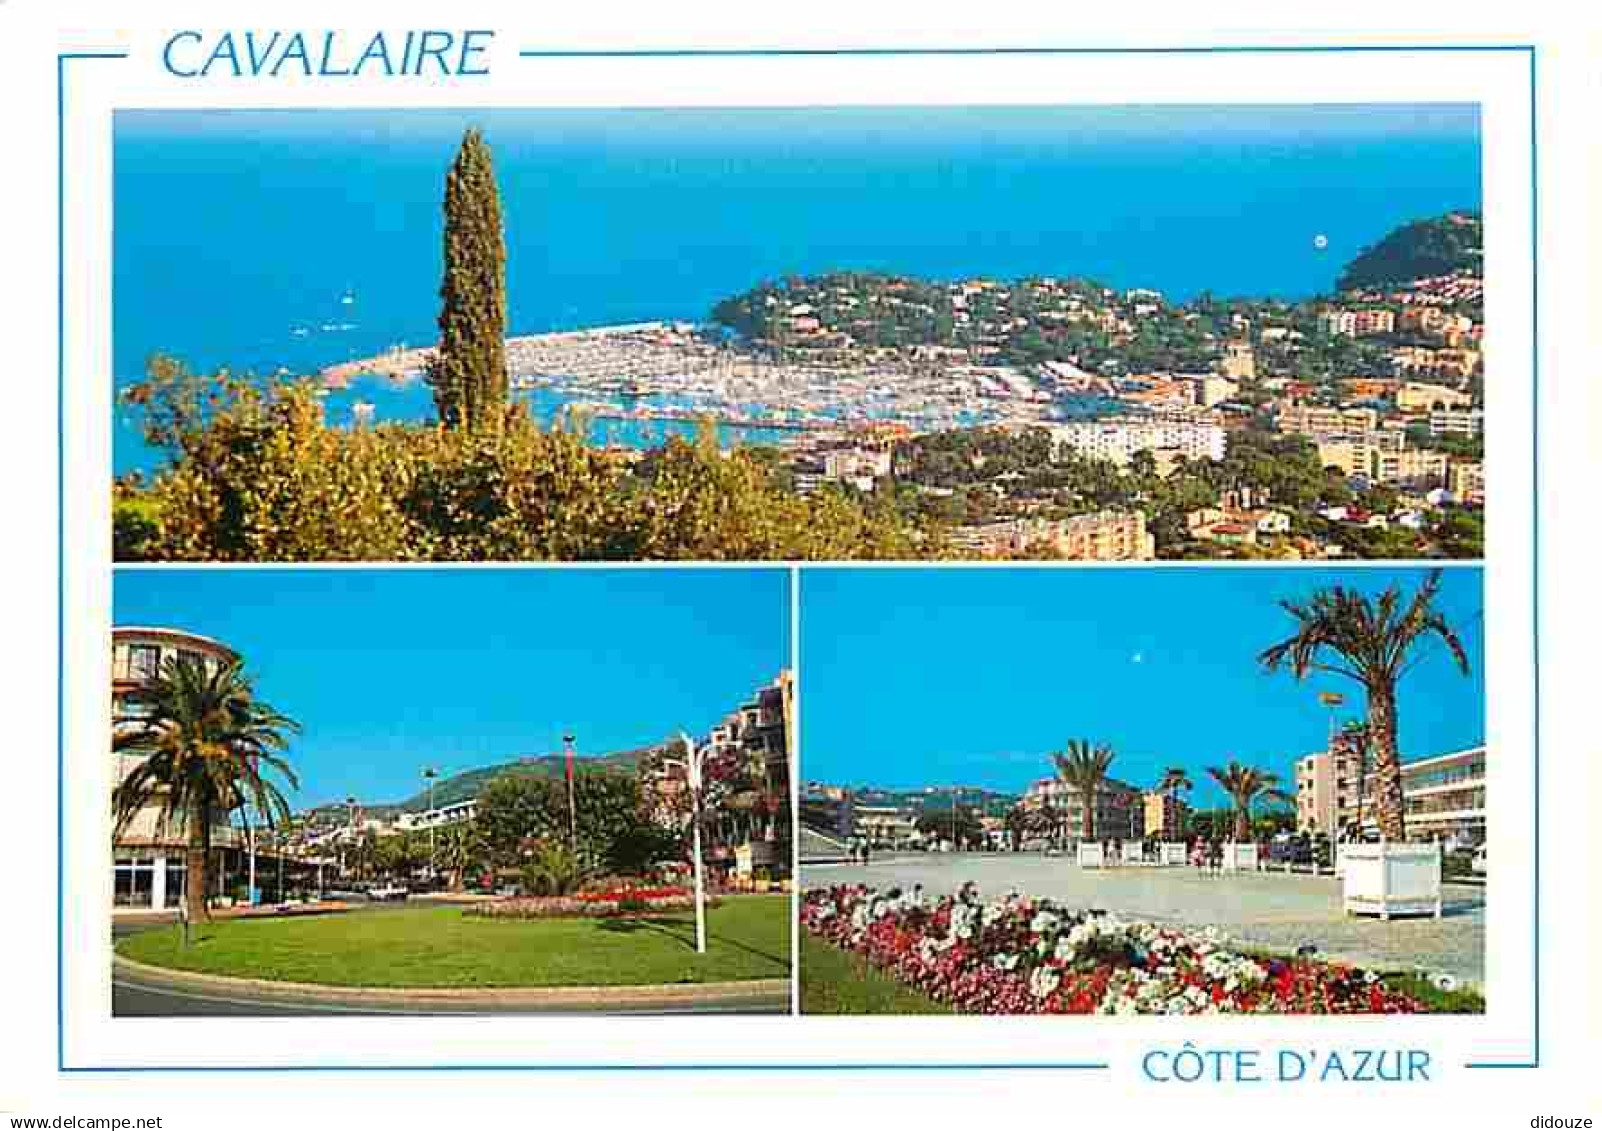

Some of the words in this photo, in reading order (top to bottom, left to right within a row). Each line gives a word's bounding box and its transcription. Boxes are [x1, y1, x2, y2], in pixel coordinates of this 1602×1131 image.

[163, 30, 495, 78] CAVALAIRE
[1142, 1041, 1262, 1082] CÔTE
[1278, 1049, 1431, 1082] D'AZUR
